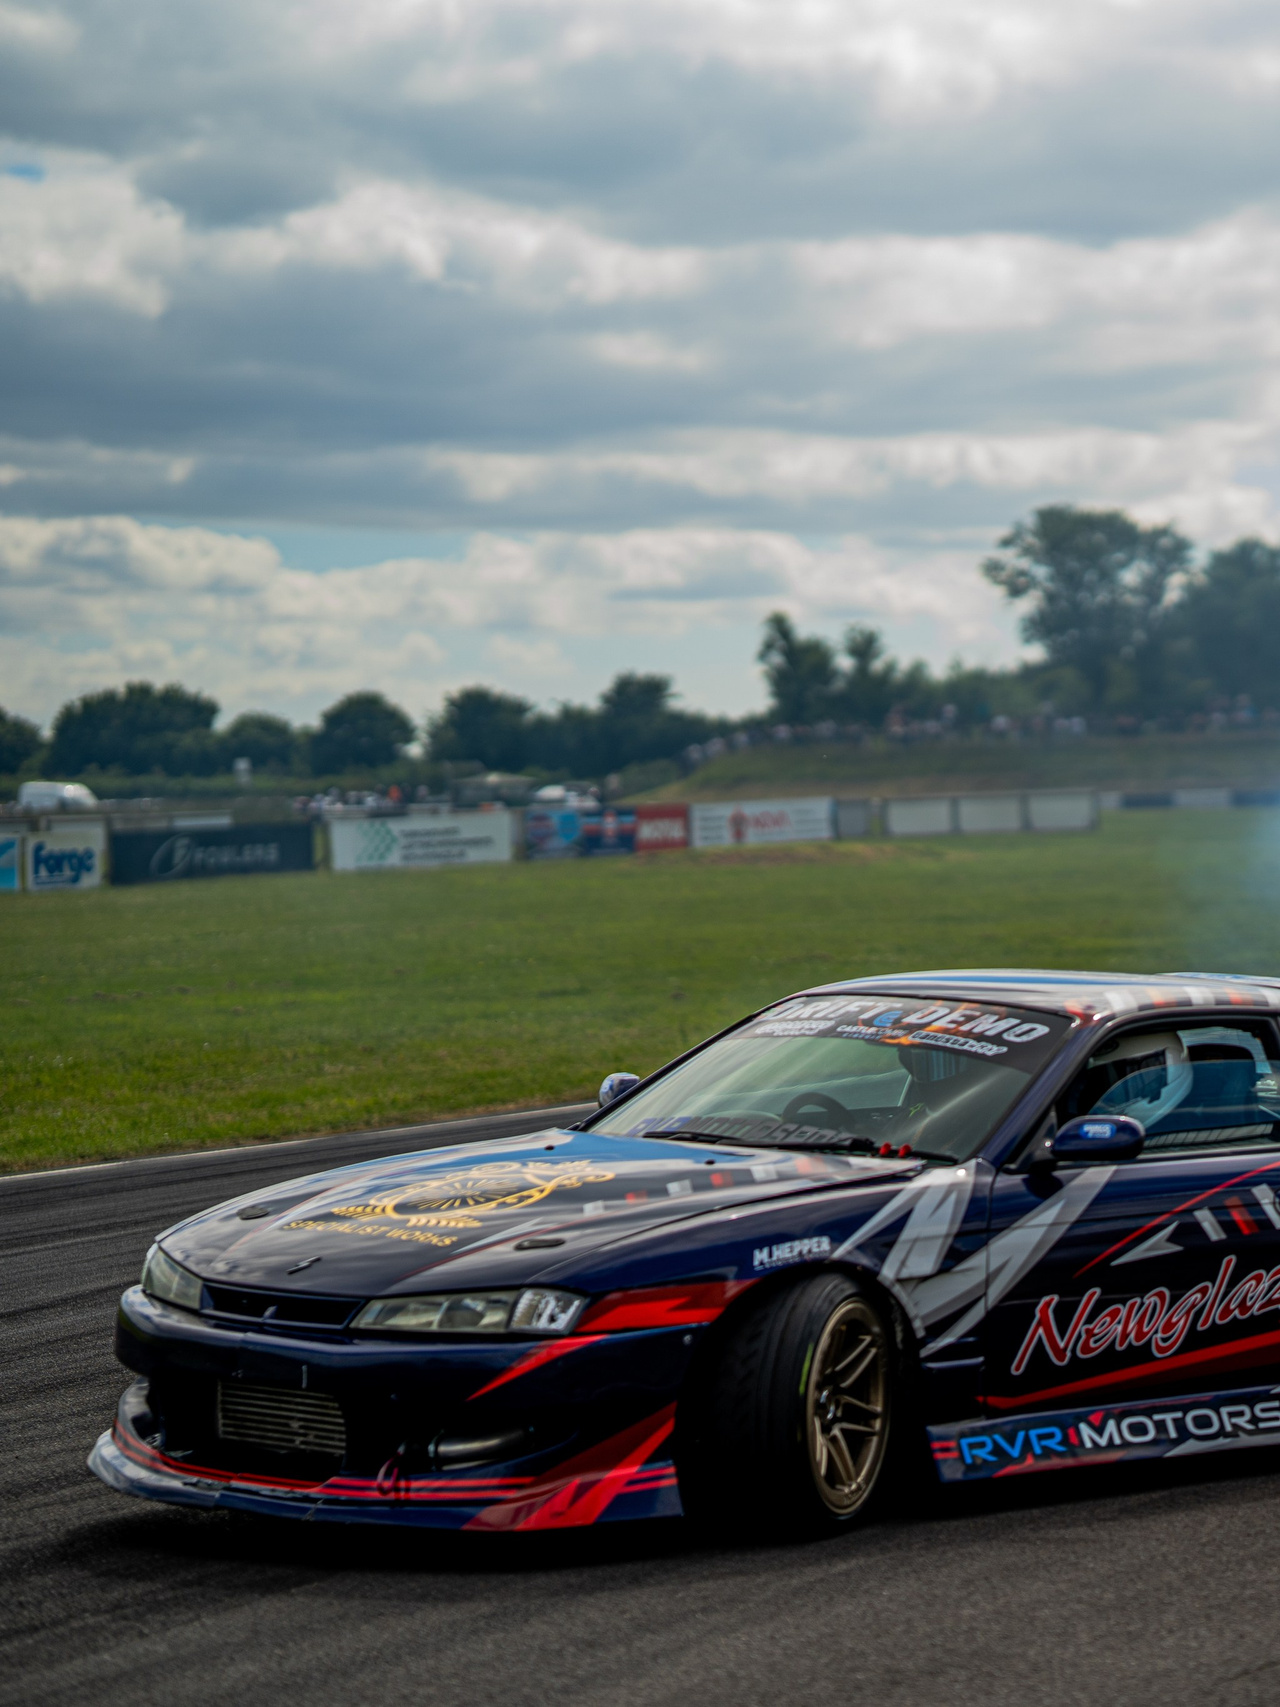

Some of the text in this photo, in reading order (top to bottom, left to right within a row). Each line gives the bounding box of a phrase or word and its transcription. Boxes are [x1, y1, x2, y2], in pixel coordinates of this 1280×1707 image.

[764, 1000, 1050, 1042] DRIFT DEMO
[681, 1116, 858, 1146] MOTORSPO
[283, 1220, 458, 1246] SPECIALIST WORKS
[959, 1425, 1067, 1464] RVR
